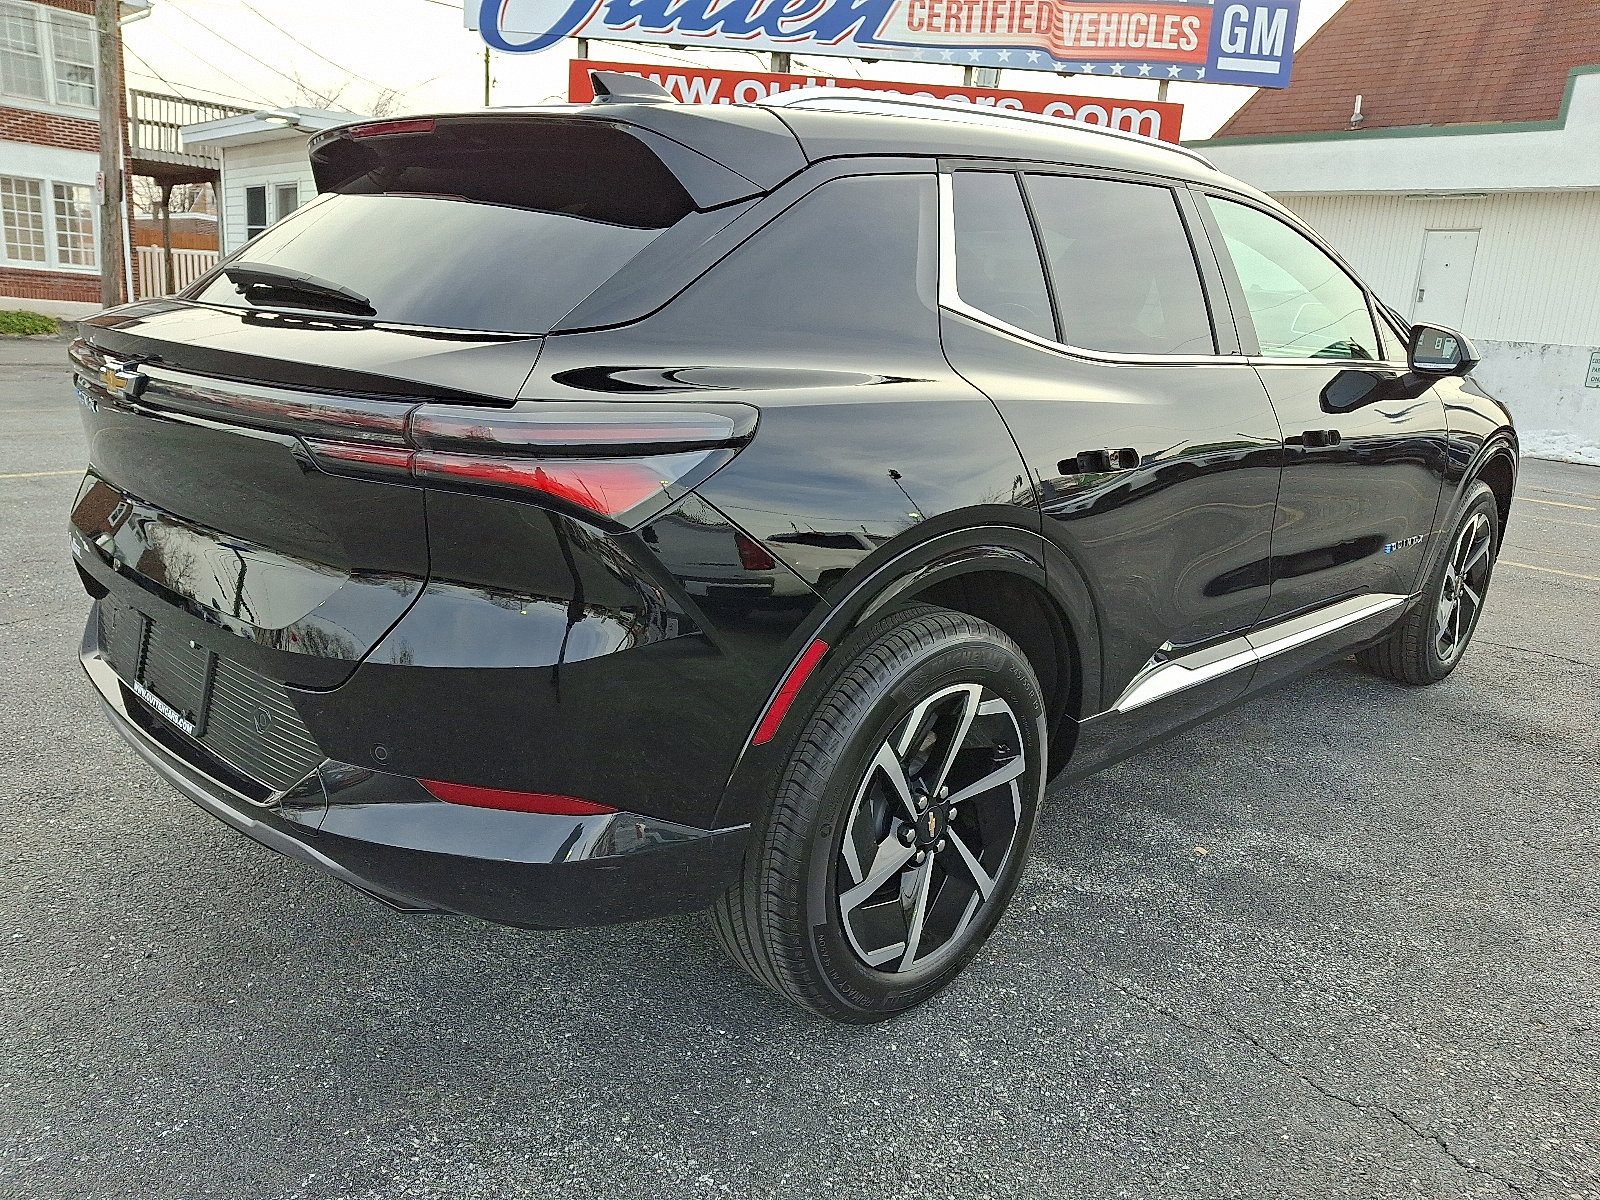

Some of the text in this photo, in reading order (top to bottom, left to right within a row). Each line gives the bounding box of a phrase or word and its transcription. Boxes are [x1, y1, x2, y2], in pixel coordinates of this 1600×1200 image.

[906, 0, 1200, 51] CERTIFIED VEHICLES
[1220, 4, 1289, 57] GM
